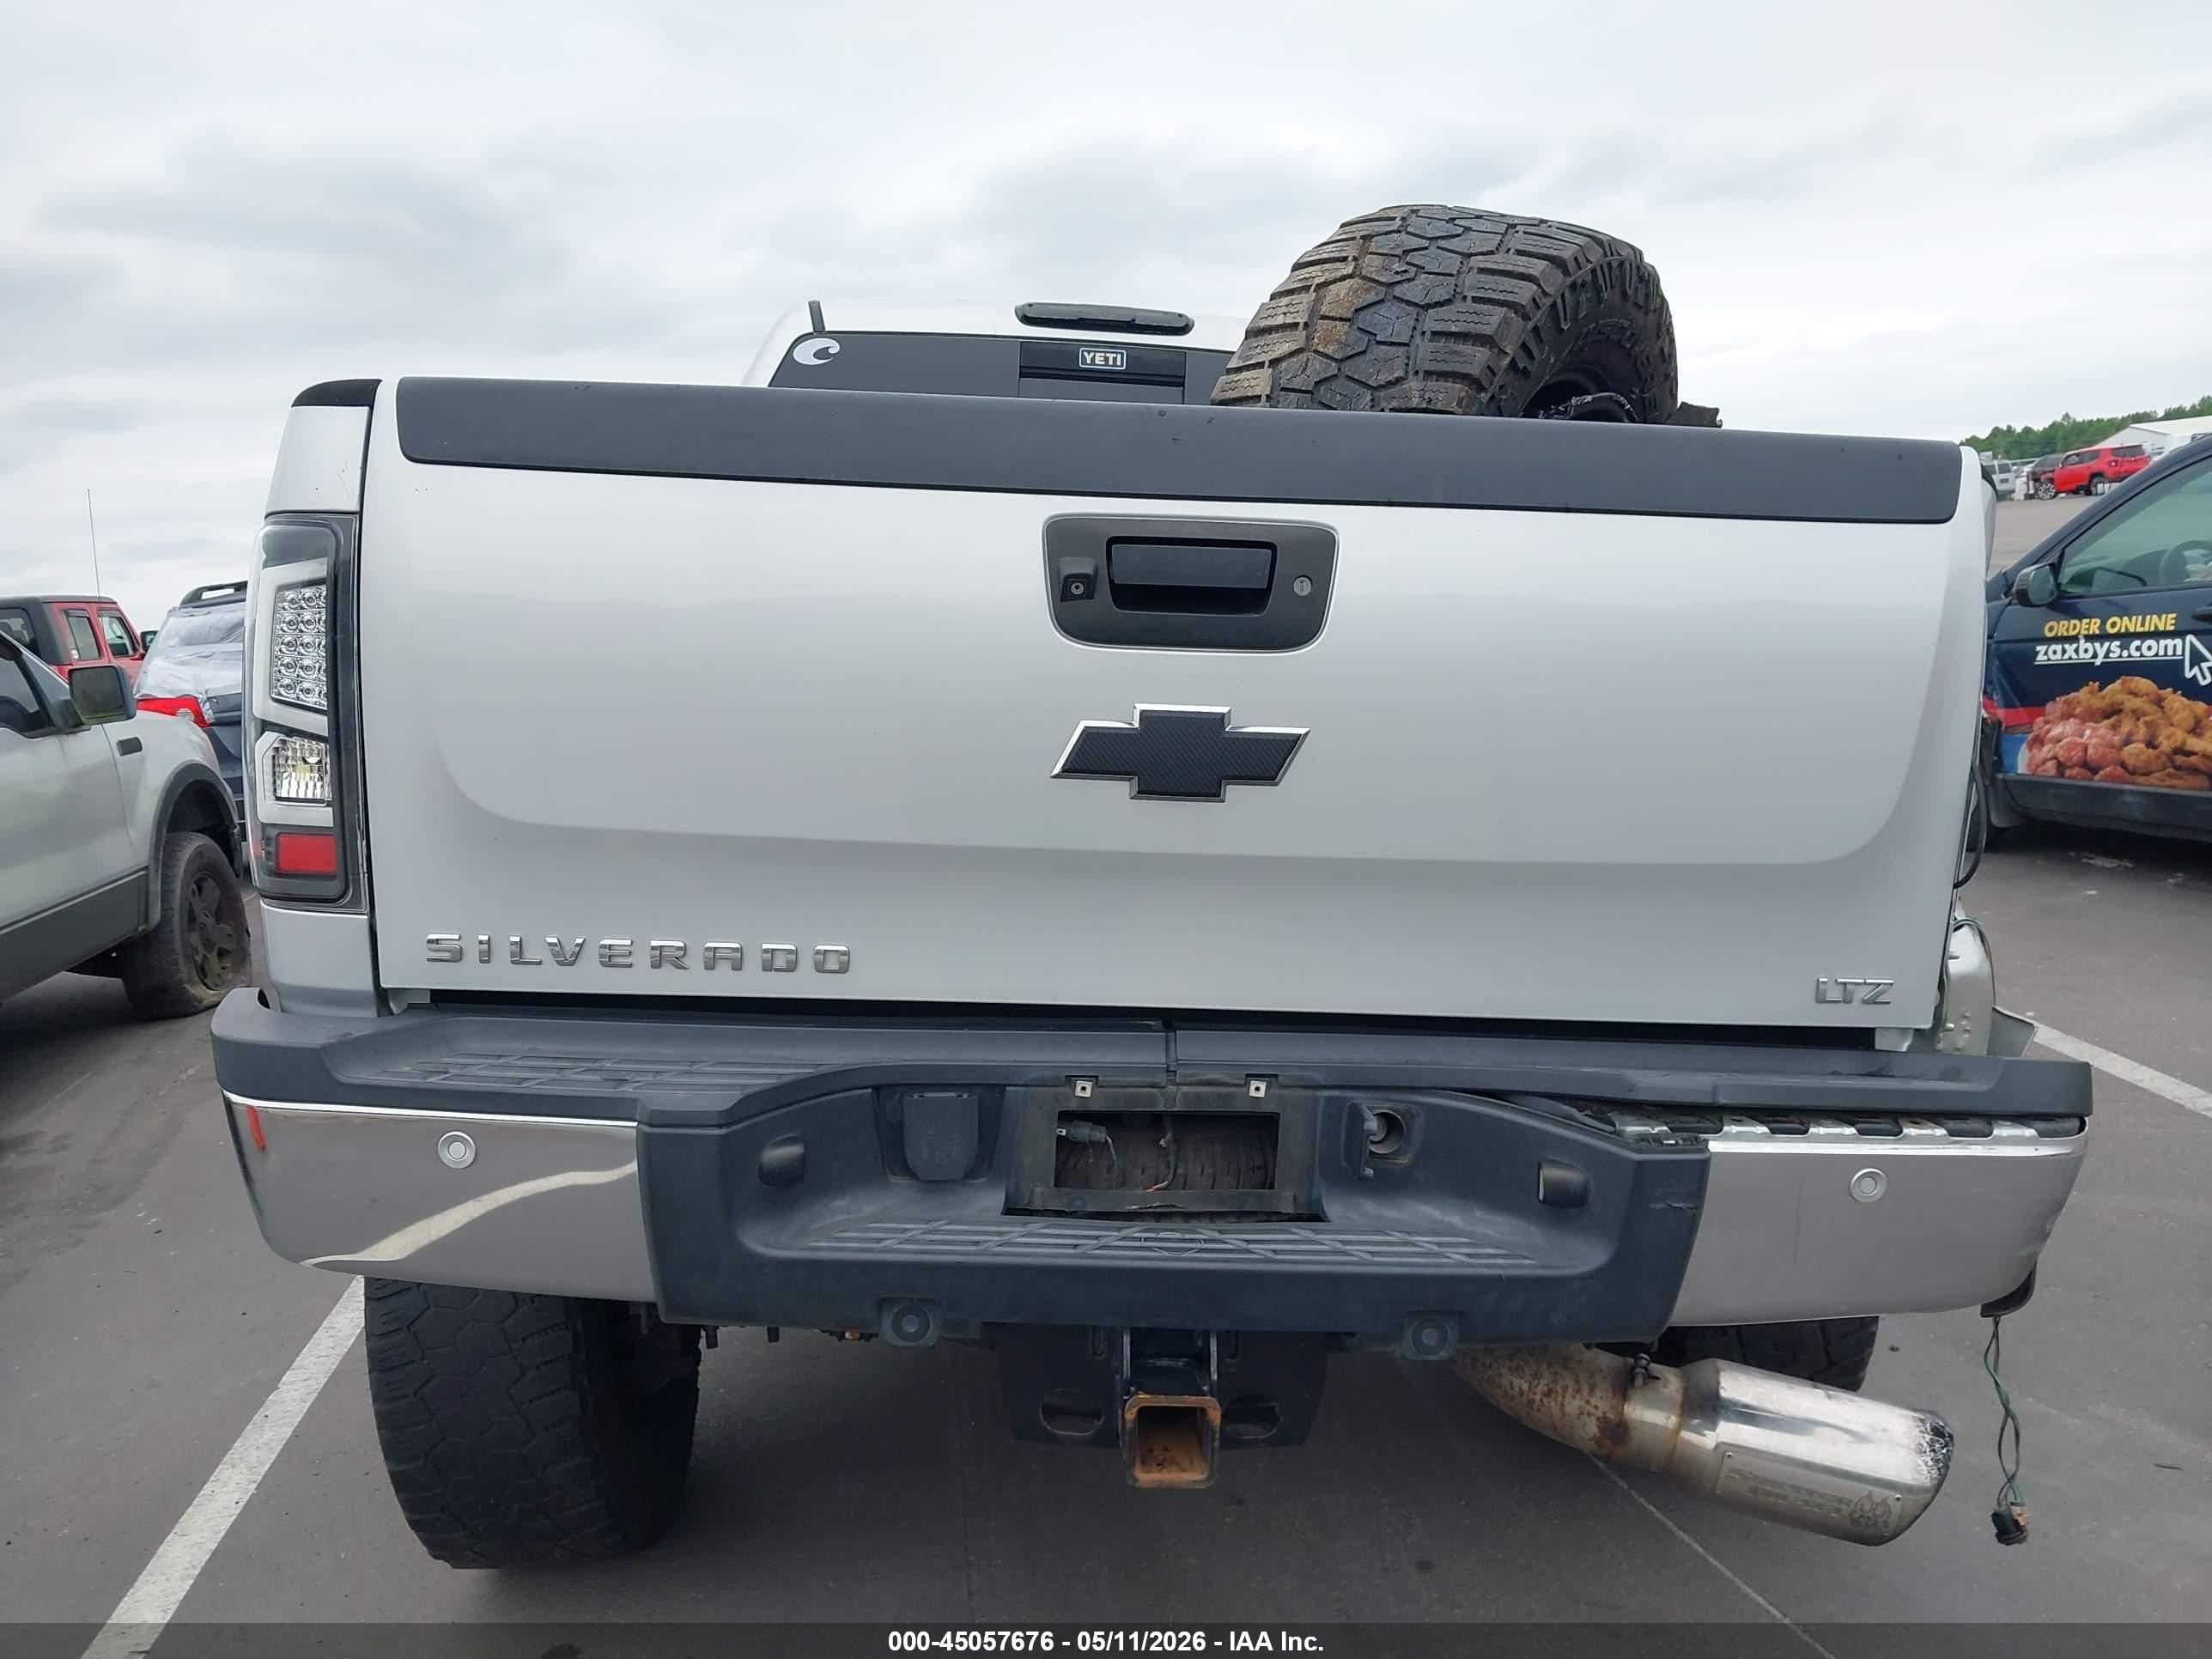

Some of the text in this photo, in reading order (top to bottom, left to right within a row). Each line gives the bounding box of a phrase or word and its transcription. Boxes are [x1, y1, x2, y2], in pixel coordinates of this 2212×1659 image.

[1082, 351, 1122, 366] YETI
[2044, 613, 2177, 638] ORDER ONLINE
[2035, 635, 2183, 665] zaxbys.com
[425, 933, 850, 974] SILVERADO
[1814, 977, 1894, 1005] LTZ
